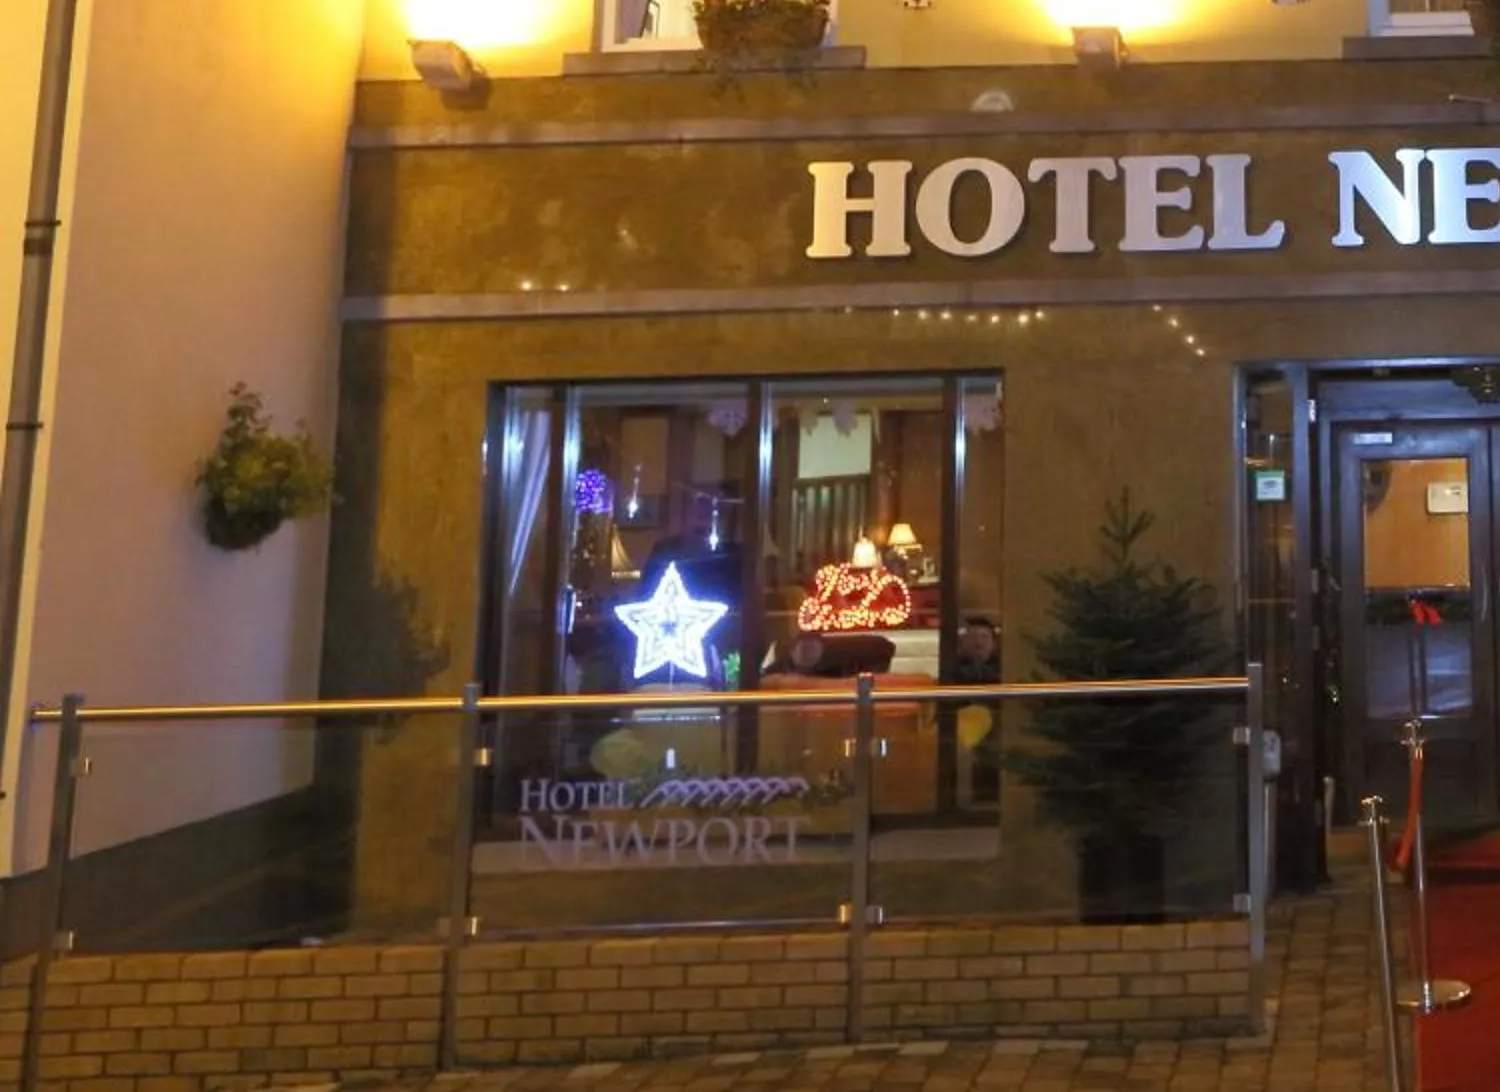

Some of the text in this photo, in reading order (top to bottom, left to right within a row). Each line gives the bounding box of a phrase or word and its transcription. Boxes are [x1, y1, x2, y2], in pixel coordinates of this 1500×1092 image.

[806, 156, 1285, 259] HOTEL
[520, 778, 634, 812] HOTEL
[517, 814, 811, 868] NEWPORT
